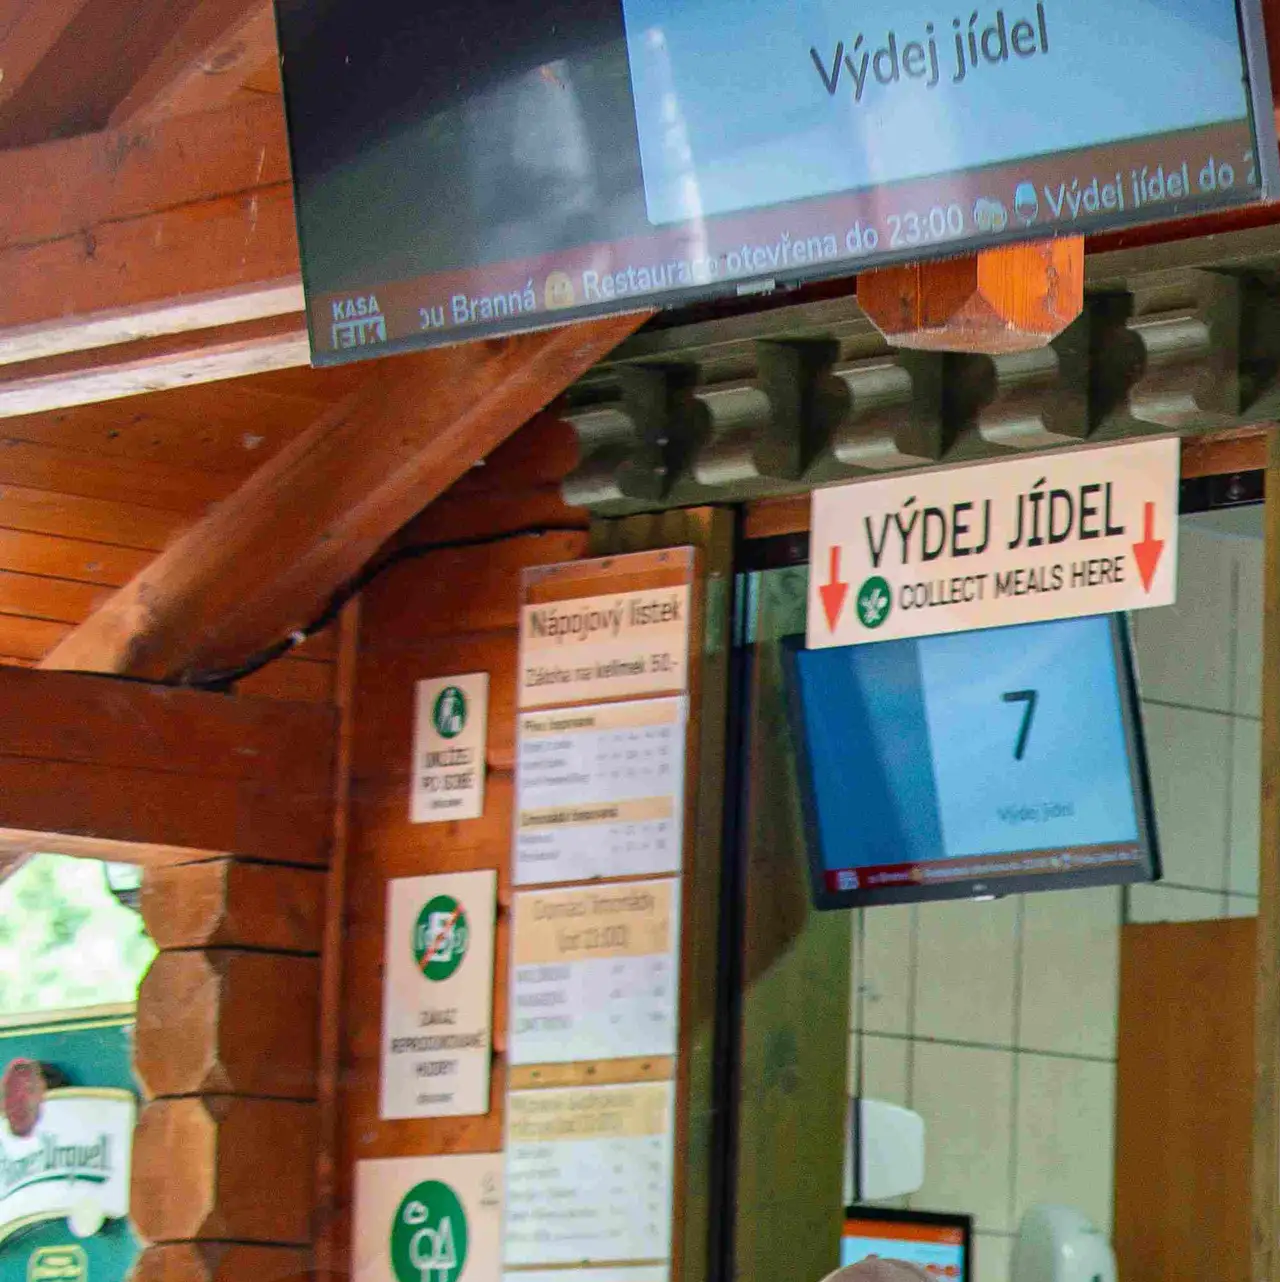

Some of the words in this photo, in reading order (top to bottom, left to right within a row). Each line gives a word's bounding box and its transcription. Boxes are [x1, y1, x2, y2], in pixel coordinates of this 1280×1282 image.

[812, 18, 939, 103] Výdej
[952, 1, 1050, 83] jídel
[451, 279, 536, 325] Branná
[727, 231, 837, 278] otevřena
[846, 222, 878, 252] do
[888, 204, 964, 247] 23:00
[1044, 177, 1124, 222] Výdej
[1131, 163, 1189, 210] jídel
[1199, 157, 1235, 192] do
[333, 295, 379, 321] KASA
[864, 497, 993, 569] VÝDEJ
[1008, 477, 1125, 549] JÍDEL
[899, 574, 986, 610] COLLECT
[994, 565, 1063, 599] MEALS
[1072, 556, 1125, 589] HERE
[530, 603, 624, 645] Nápojový
[630, 595, 681, 625] lístek
[1001, 689, 1039, 761] 7
